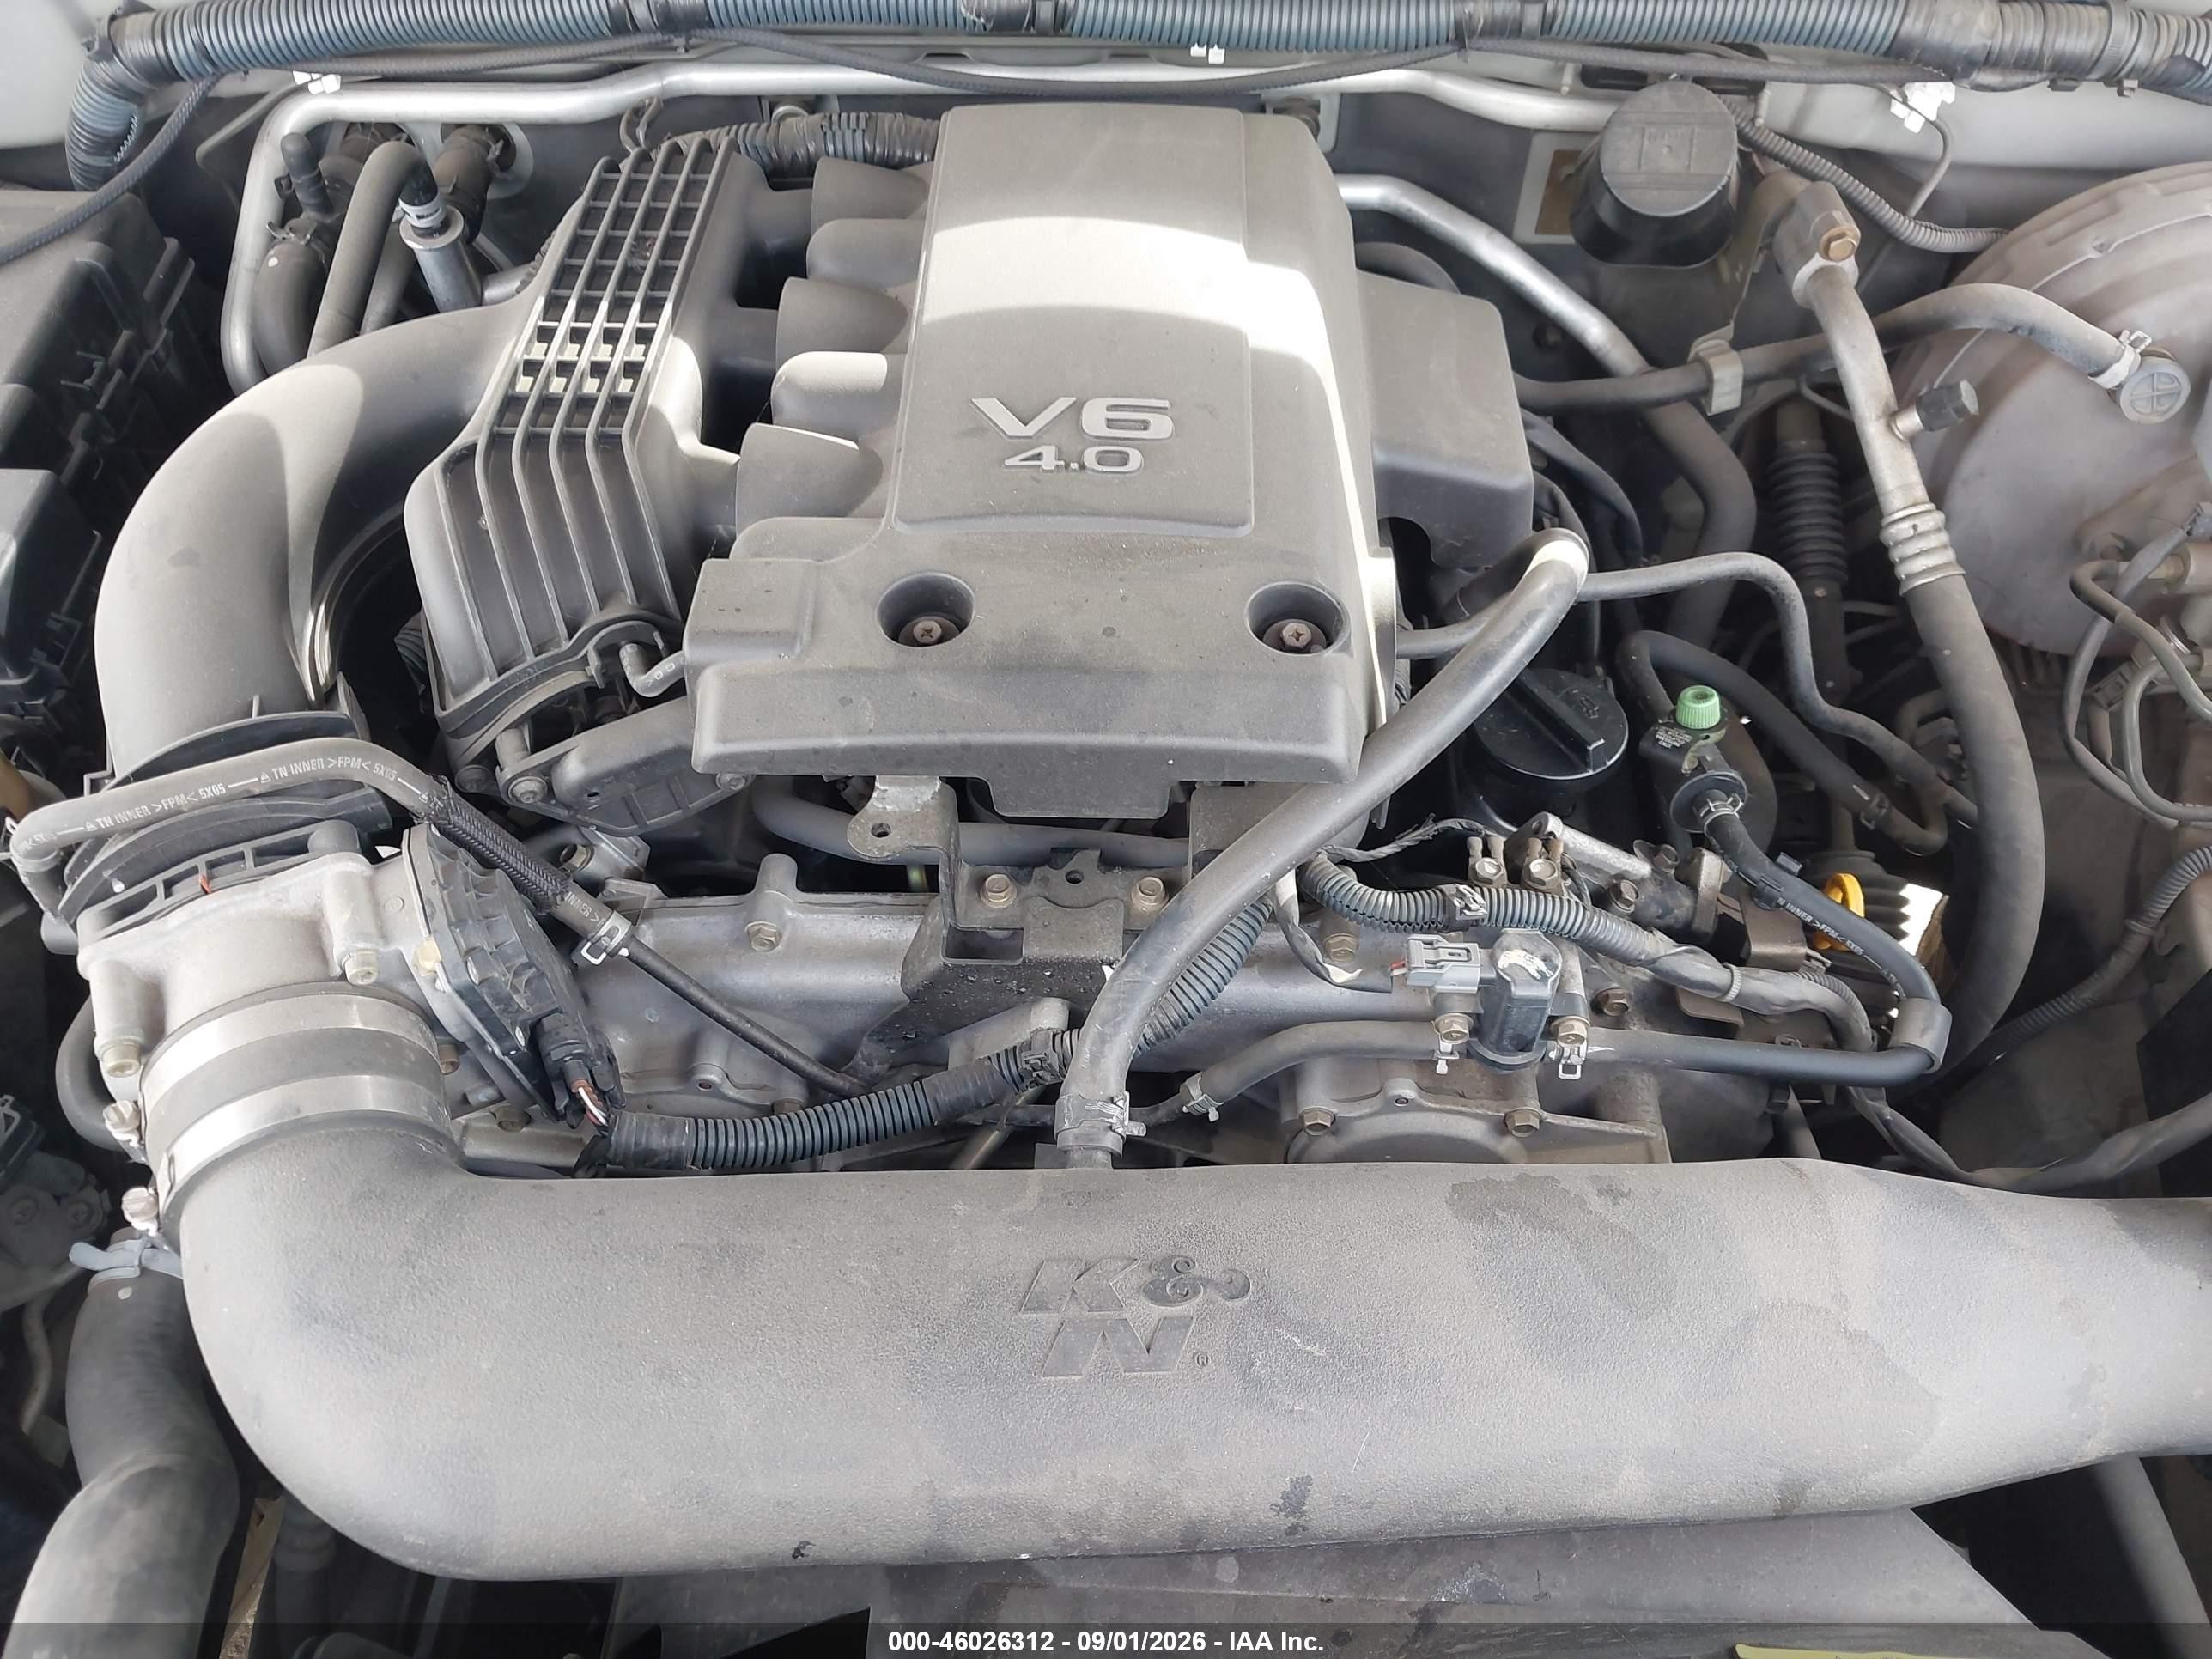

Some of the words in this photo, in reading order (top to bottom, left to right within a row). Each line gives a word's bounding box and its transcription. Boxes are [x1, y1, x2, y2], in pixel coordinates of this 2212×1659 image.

[970, 397, 1174, 440] V6
[1004, 445, 1144, 473] 4.0
[271, 768, 289, 781] TN
[95, 817, 115, 829] TN
[114, 805, 152, 824] INNER
